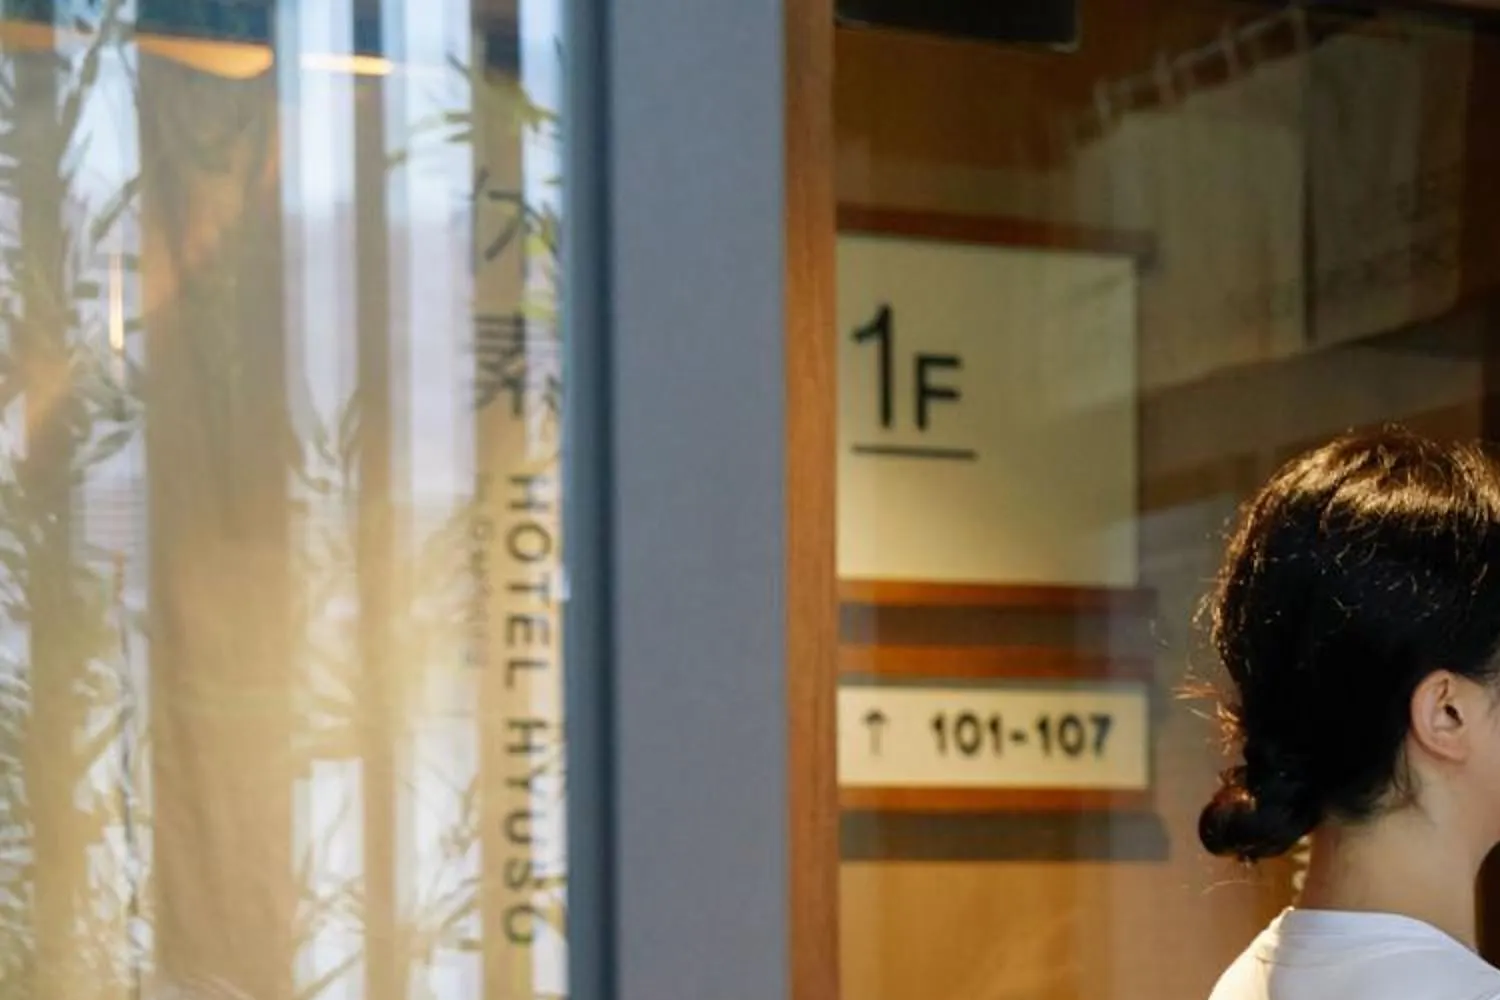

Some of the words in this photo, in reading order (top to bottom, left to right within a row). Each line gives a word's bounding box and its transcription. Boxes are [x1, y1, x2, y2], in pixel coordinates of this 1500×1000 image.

[851, 303, 963, 432] 1F
[504, 473, 553, 692] HOTEL
[928, 711, 1115, 758] 101-107
